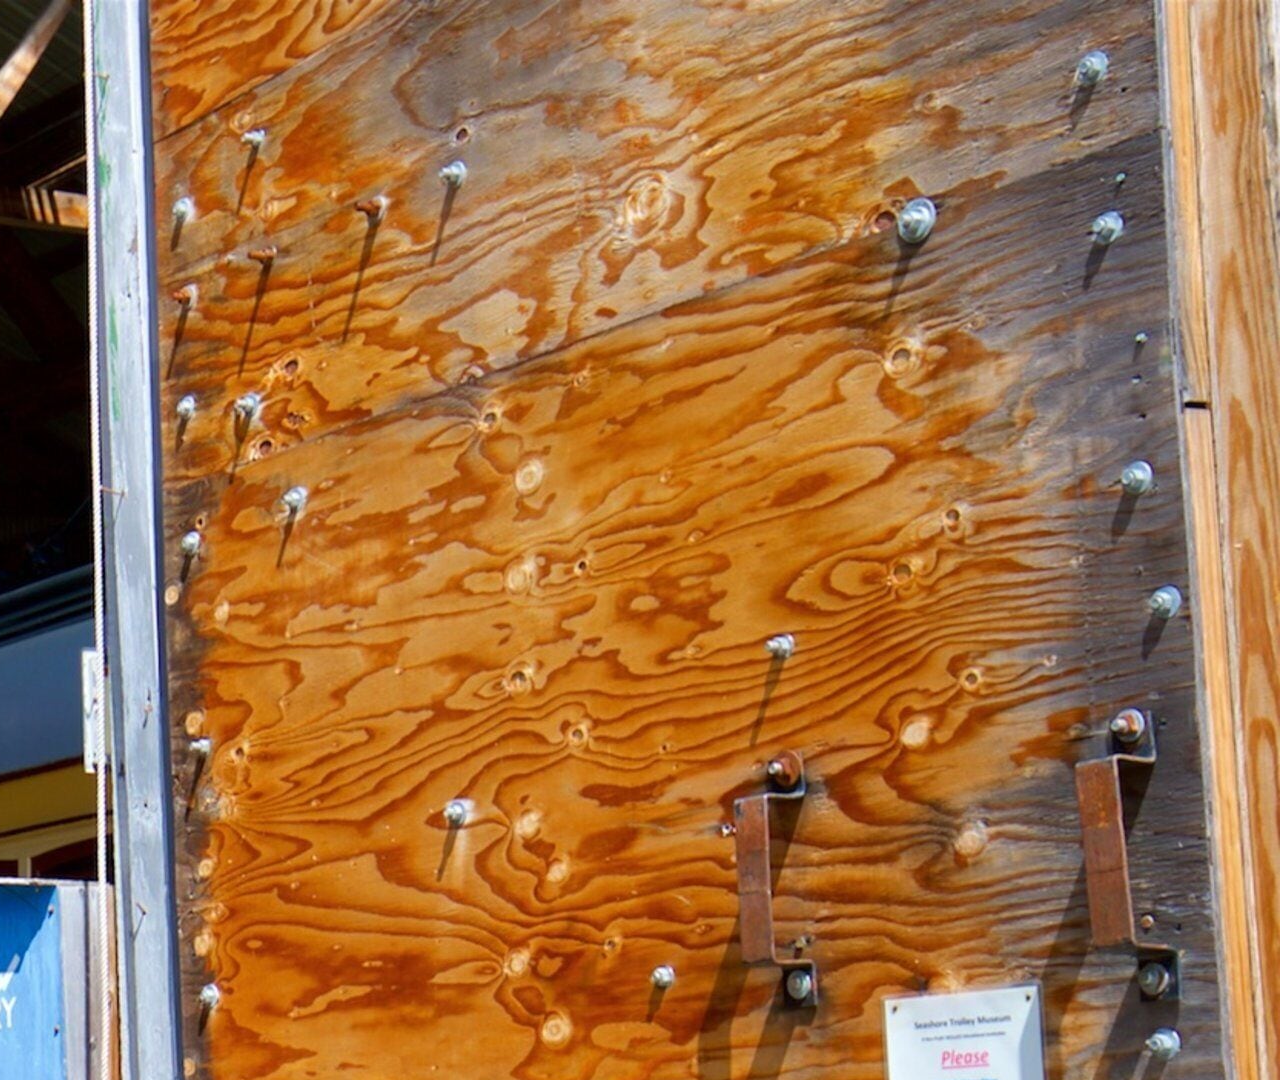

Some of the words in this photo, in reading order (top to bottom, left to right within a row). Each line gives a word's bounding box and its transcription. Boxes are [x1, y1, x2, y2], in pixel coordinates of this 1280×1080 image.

[914, 1020, 948, 1029] Seashore
[949, 1017, 975, 1027] Trolley
[977, 1014, 1012, 1024] Museum
[941, 1049, 990, 1068] Please
